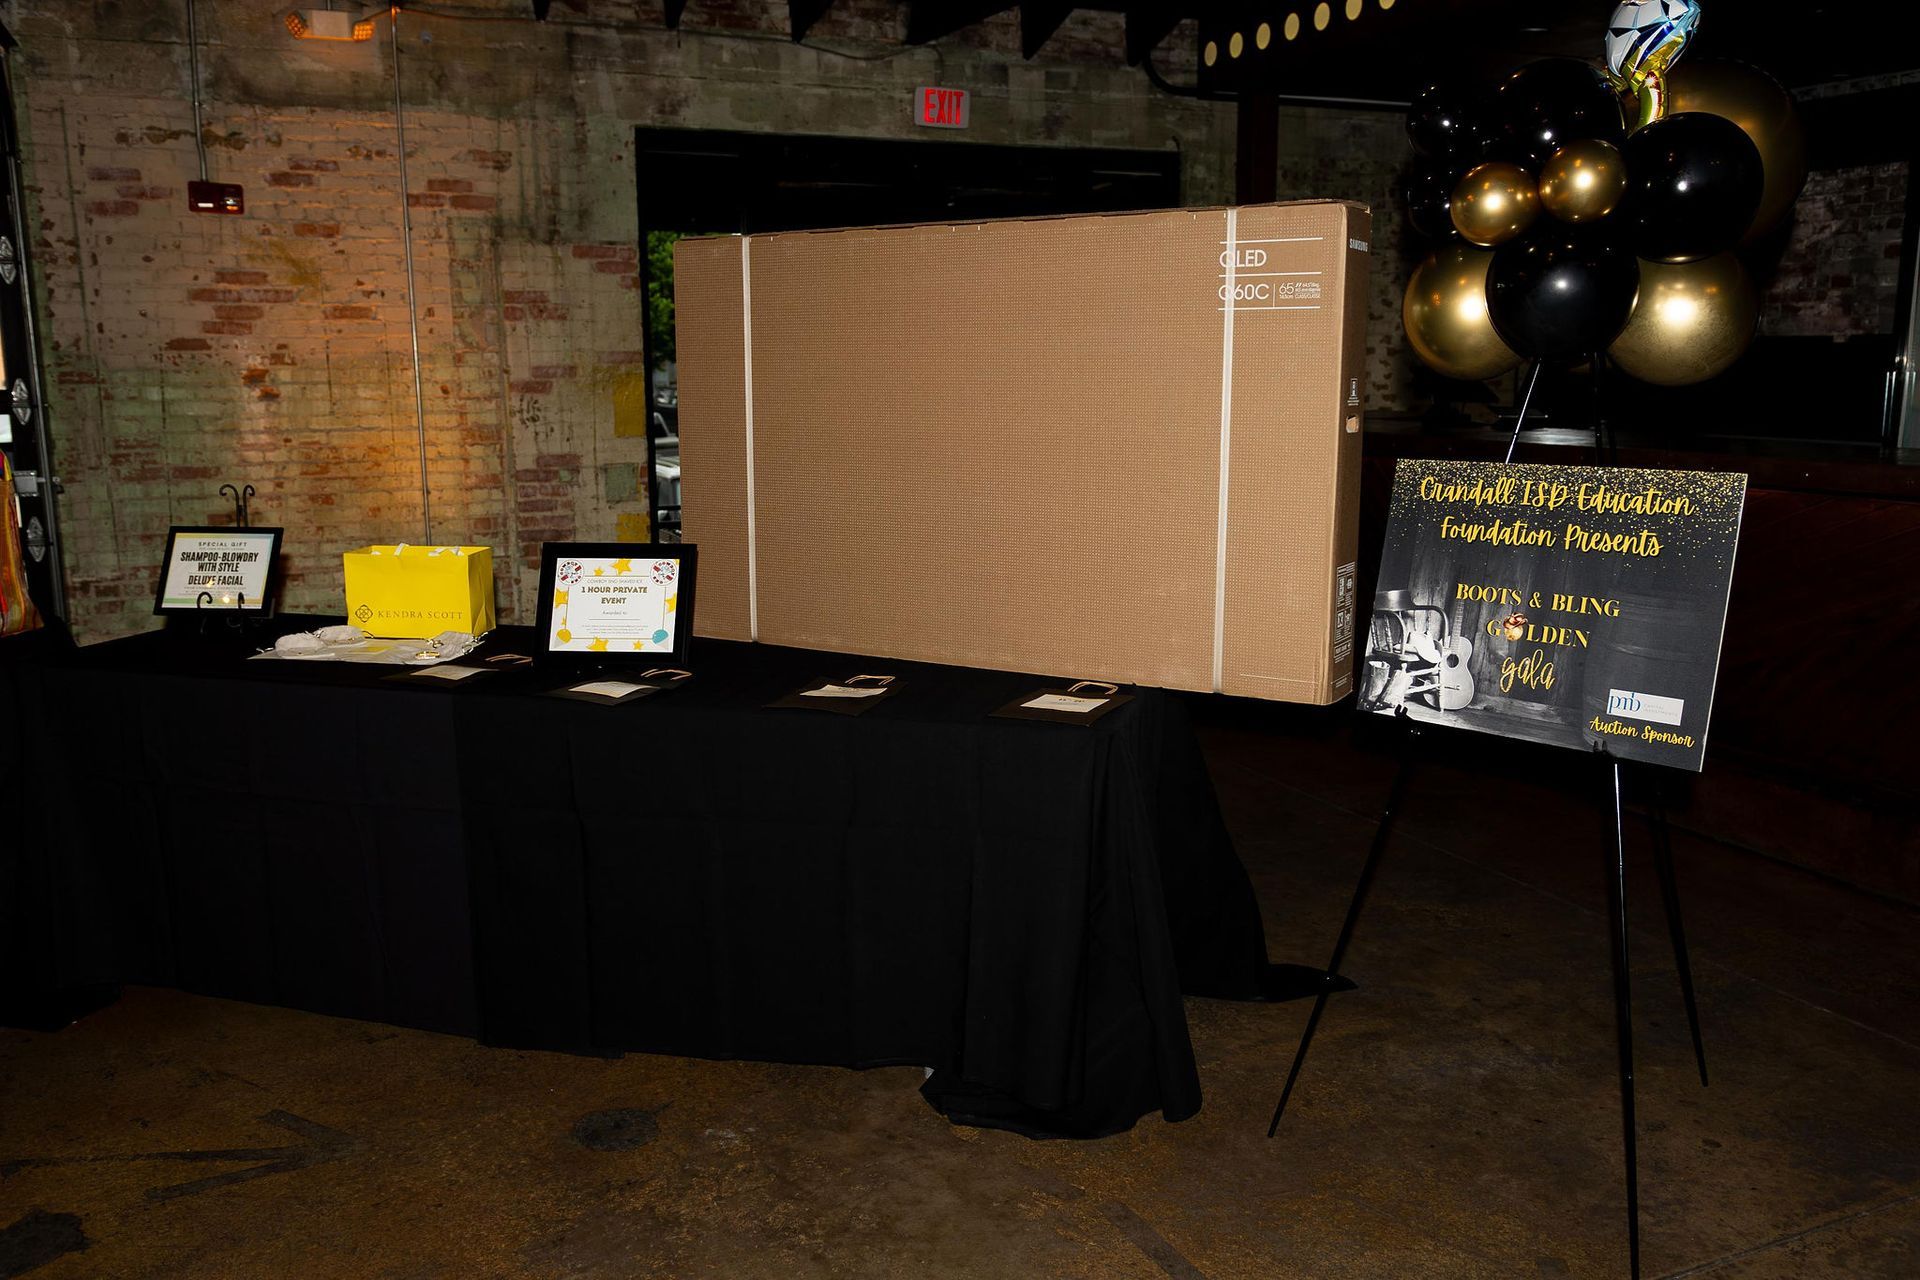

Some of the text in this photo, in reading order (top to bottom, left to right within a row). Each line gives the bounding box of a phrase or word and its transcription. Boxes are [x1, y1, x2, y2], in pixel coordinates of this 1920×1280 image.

[924, 87, 965, 125] EXIT
[1419, 476, 1697, 515] Crandall ISD Education
[1440, 516, 1664, 557] Foundation Presents
[180, 551, 259, 562] SHAMPOO-BLOWDRY
[198, 562, 240, 572] WITH STYLE
[188, 575, 244, 586] DELUXE FACIAL
[378, 610, 463, 620] KENDRA SCOTT
[1455, 583, 1621, 617] BOOTS & BLING
[1499, 649, 1556, 693] gala
[1589, 715, 1695, 748] Auction Sponsor
